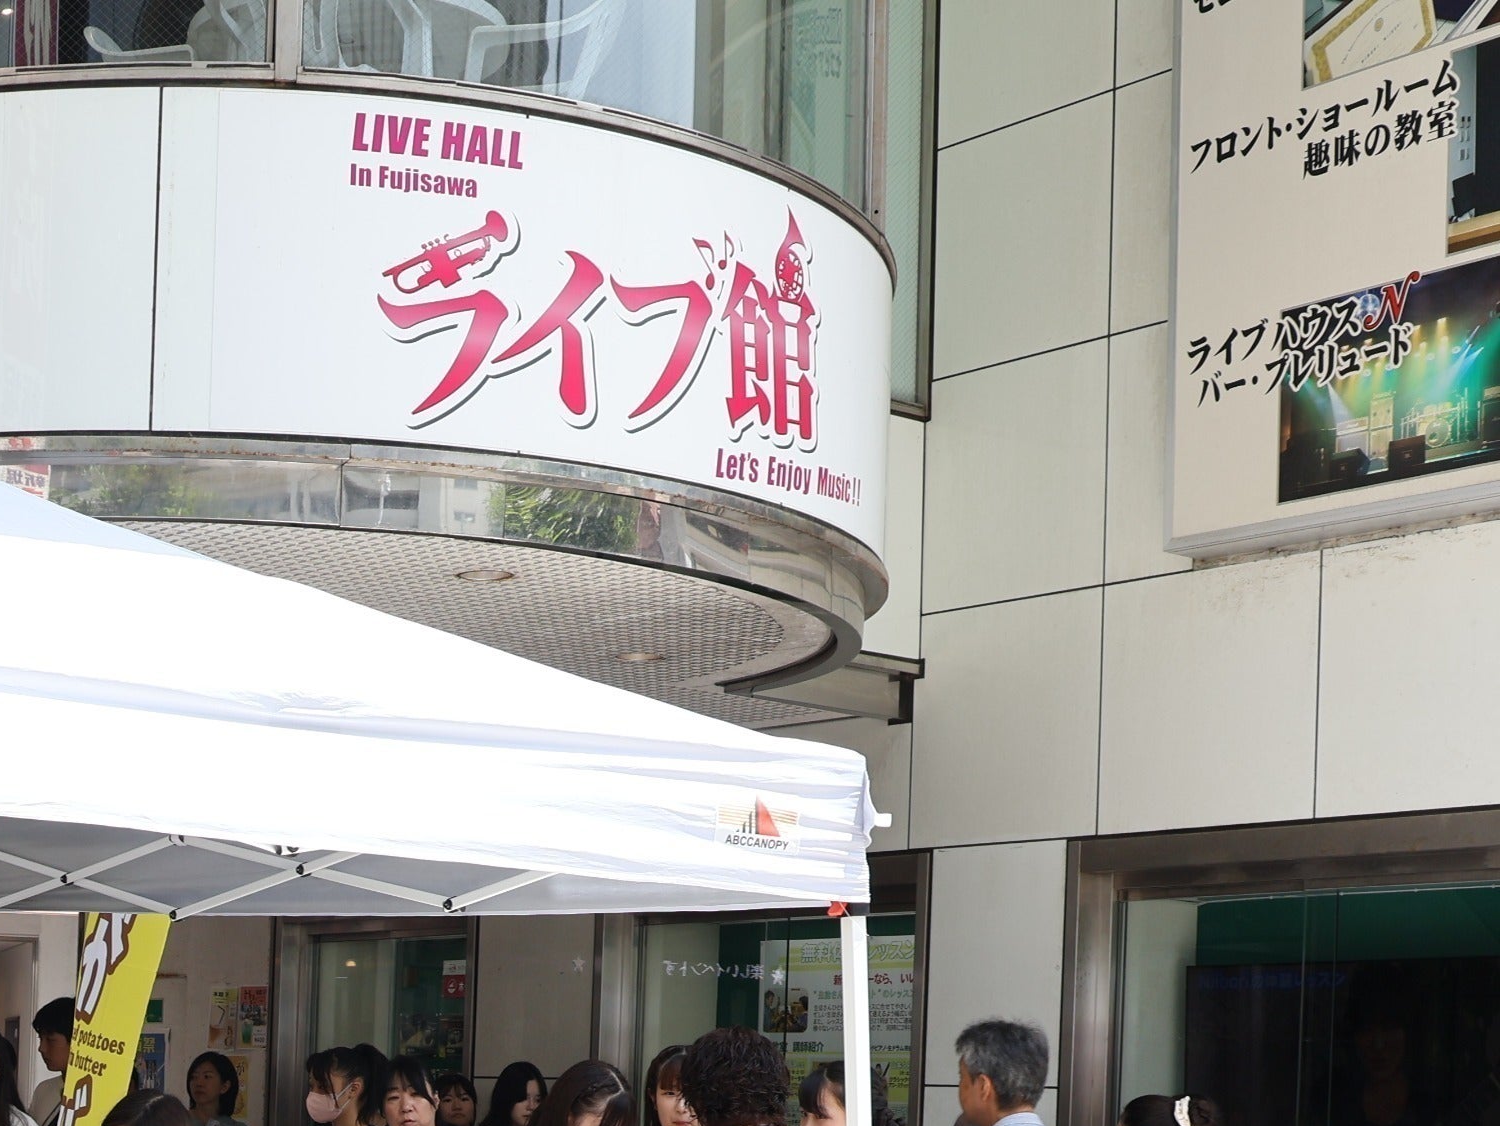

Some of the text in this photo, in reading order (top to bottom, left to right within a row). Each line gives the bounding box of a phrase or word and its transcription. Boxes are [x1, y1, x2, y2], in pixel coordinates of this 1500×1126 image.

[353, 113, 523, 170] LIVE HALL
[1190, 59, 1459, 174] フロント・ショールーム
[1303, 99, 1457, 180] 趣味の教室
[350, 164, 478, 198] In Fujisawa
[377, 204, 816, 441] ライブ館
[1186, 296, 1364, 377] ライブハウス
[1197, 323, 1414, 408] バー・プレリュード
[716, 449, 861, 507] Let's Enjoy Music!!
[725, 833, 790, 851] ABCCANOPY
[75, 1053, 108, 1077] butter
[78, 1026, 126, 1056] potatoes
